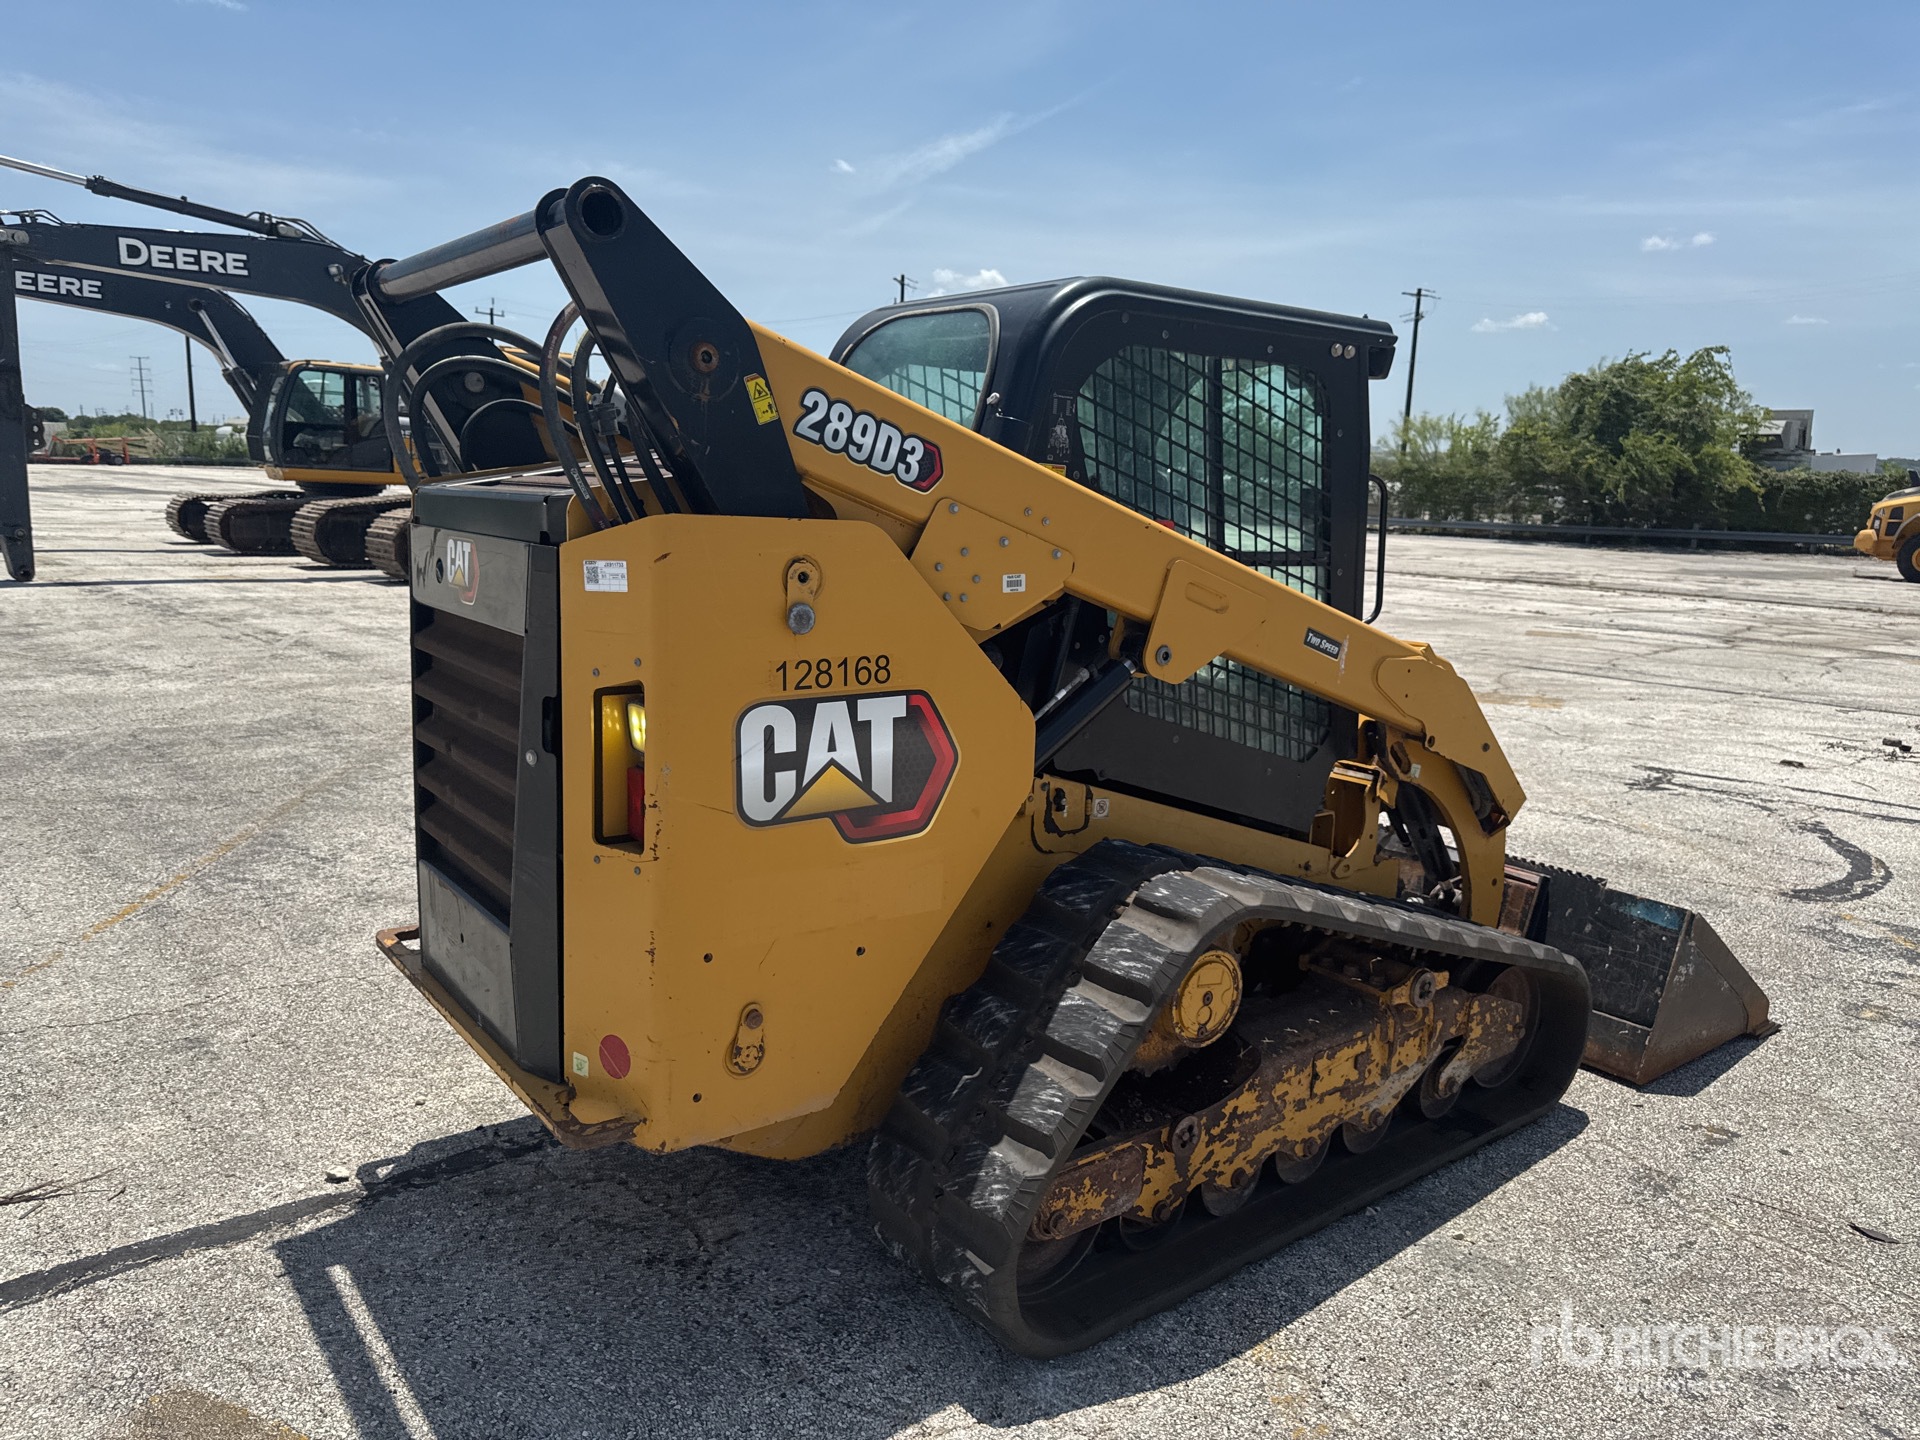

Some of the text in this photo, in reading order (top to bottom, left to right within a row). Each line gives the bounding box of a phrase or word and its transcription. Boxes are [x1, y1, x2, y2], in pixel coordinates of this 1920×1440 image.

[117, 236, 249, 277] DEERE
[14, 270, 103, 299] EERE
[795, 390, 925, 483] 289D3
[446, 538, 472, 587] CAT
[775, 654, 891, 691] 128168
[740, 695, 907, 822] CAT
